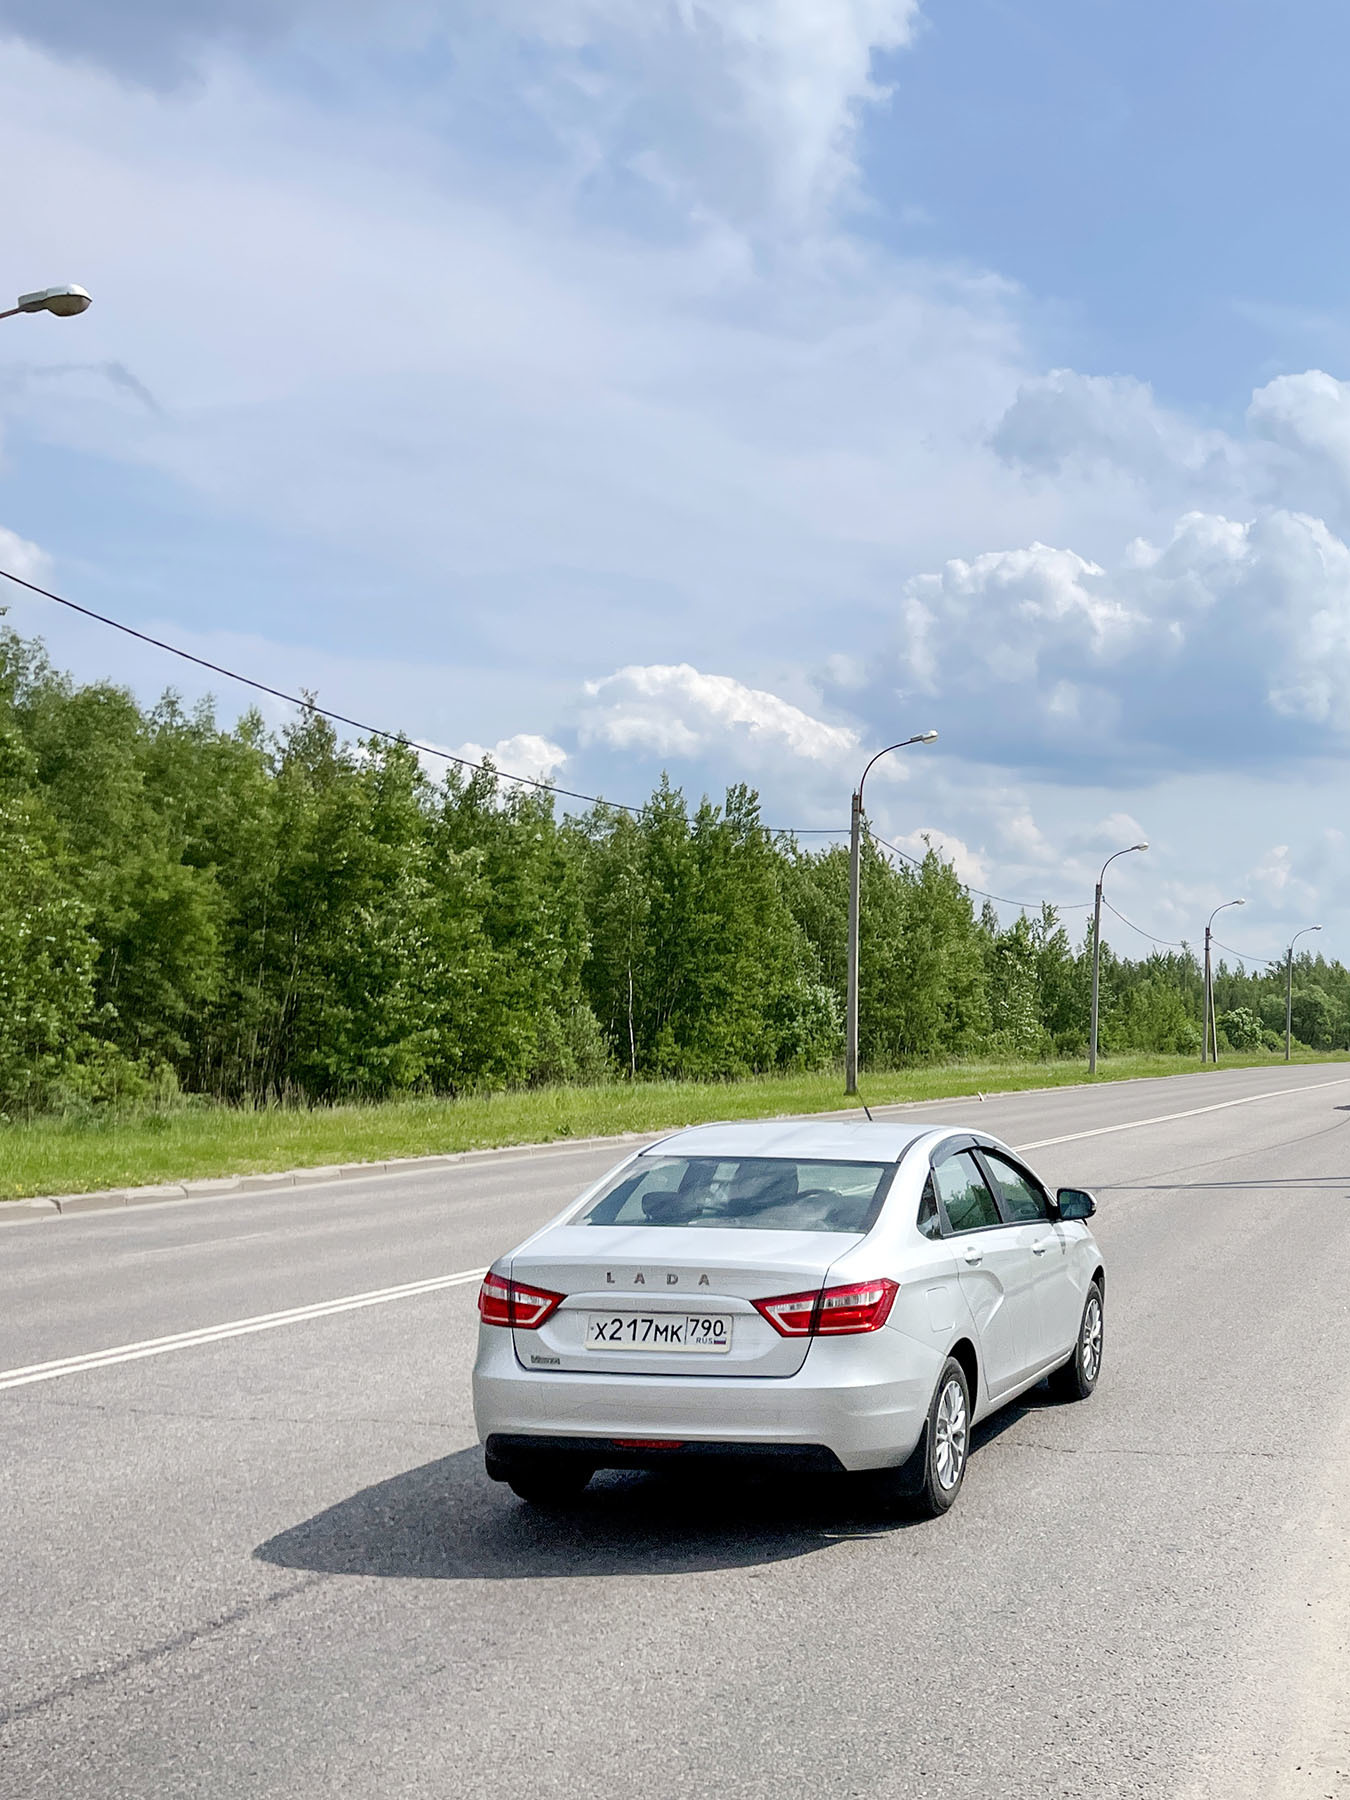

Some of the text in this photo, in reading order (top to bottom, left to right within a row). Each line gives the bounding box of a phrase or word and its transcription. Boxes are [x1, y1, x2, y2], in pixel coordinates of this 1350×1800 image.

[606, 1272, 710, 1286] LADA
[689, 1318, 725, 1337] 790
[695, 1337, 713, 1345] RUS
